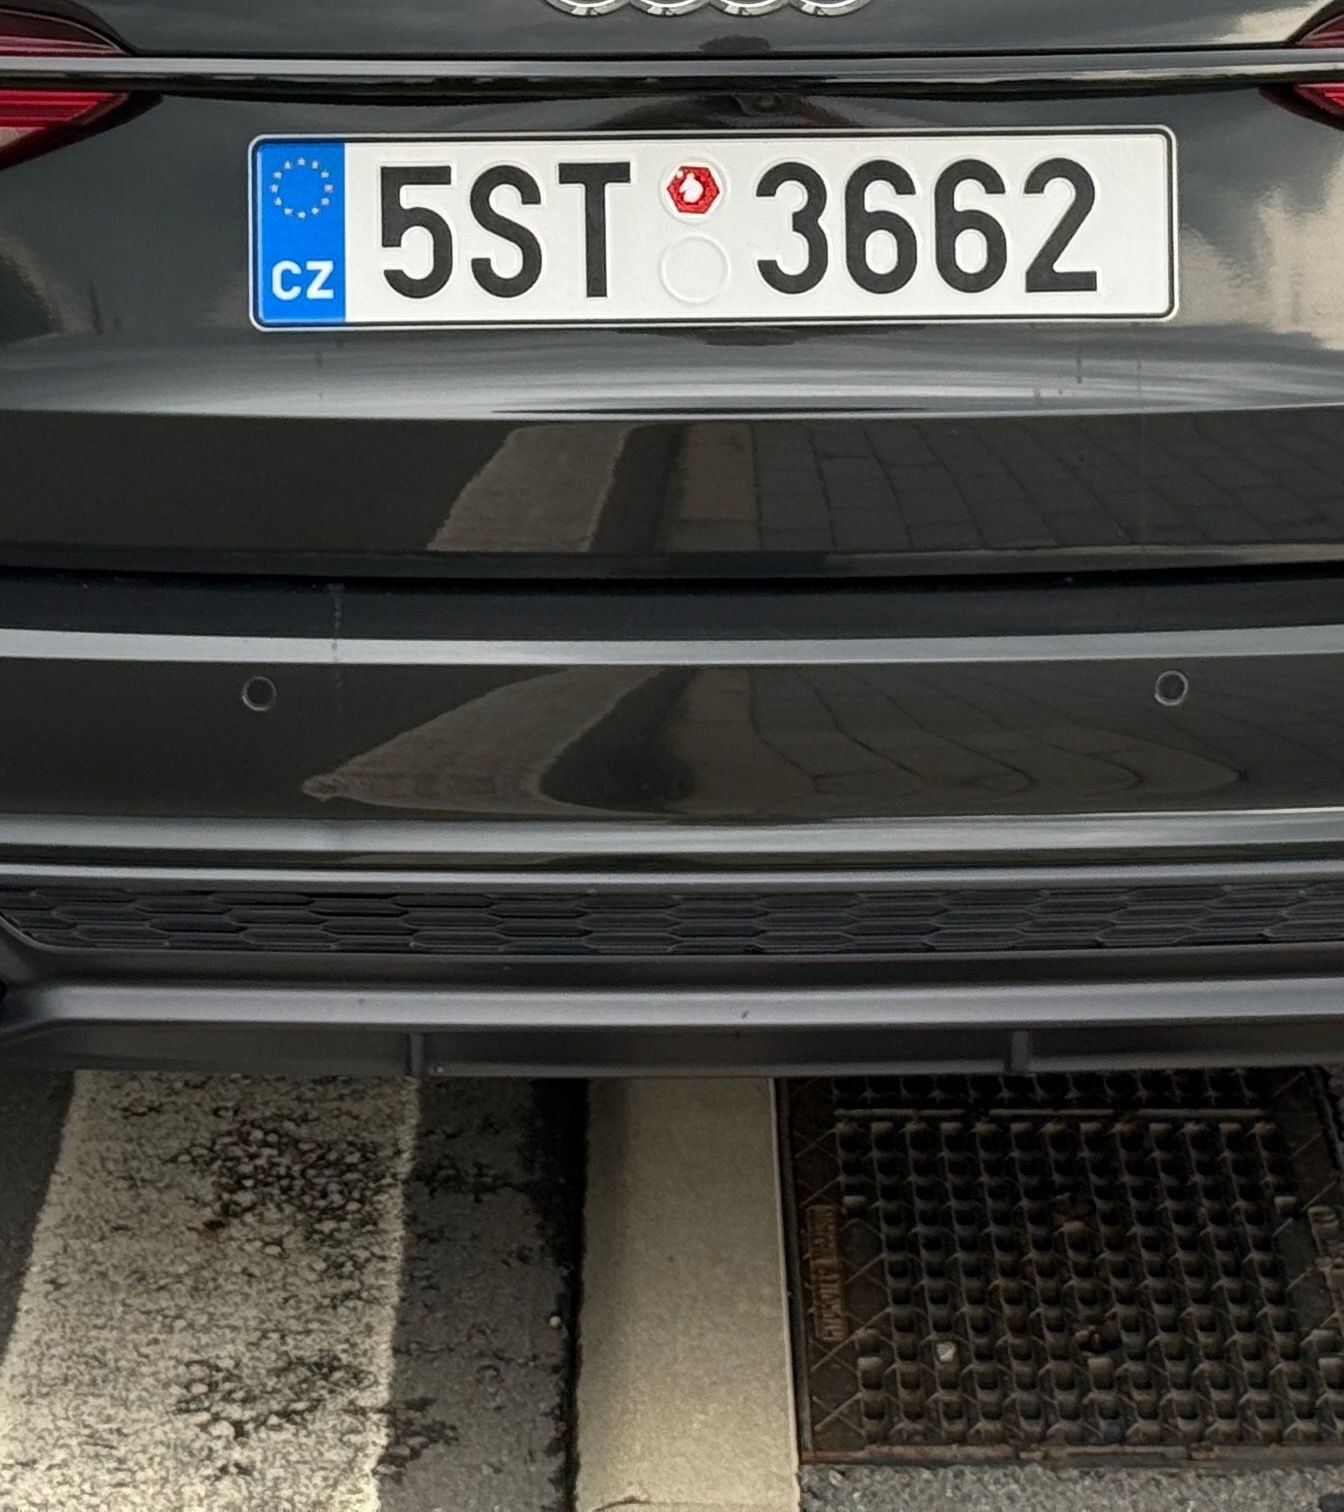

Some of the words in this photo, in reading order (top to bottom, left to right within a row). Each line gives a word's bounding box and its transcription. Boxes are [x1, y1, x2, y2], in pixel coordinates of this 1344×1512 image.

[380, 161, 631, 299] 5ST
[755, 157, 1098, 295] 3662
[271, 260, 334, 301] CZ
